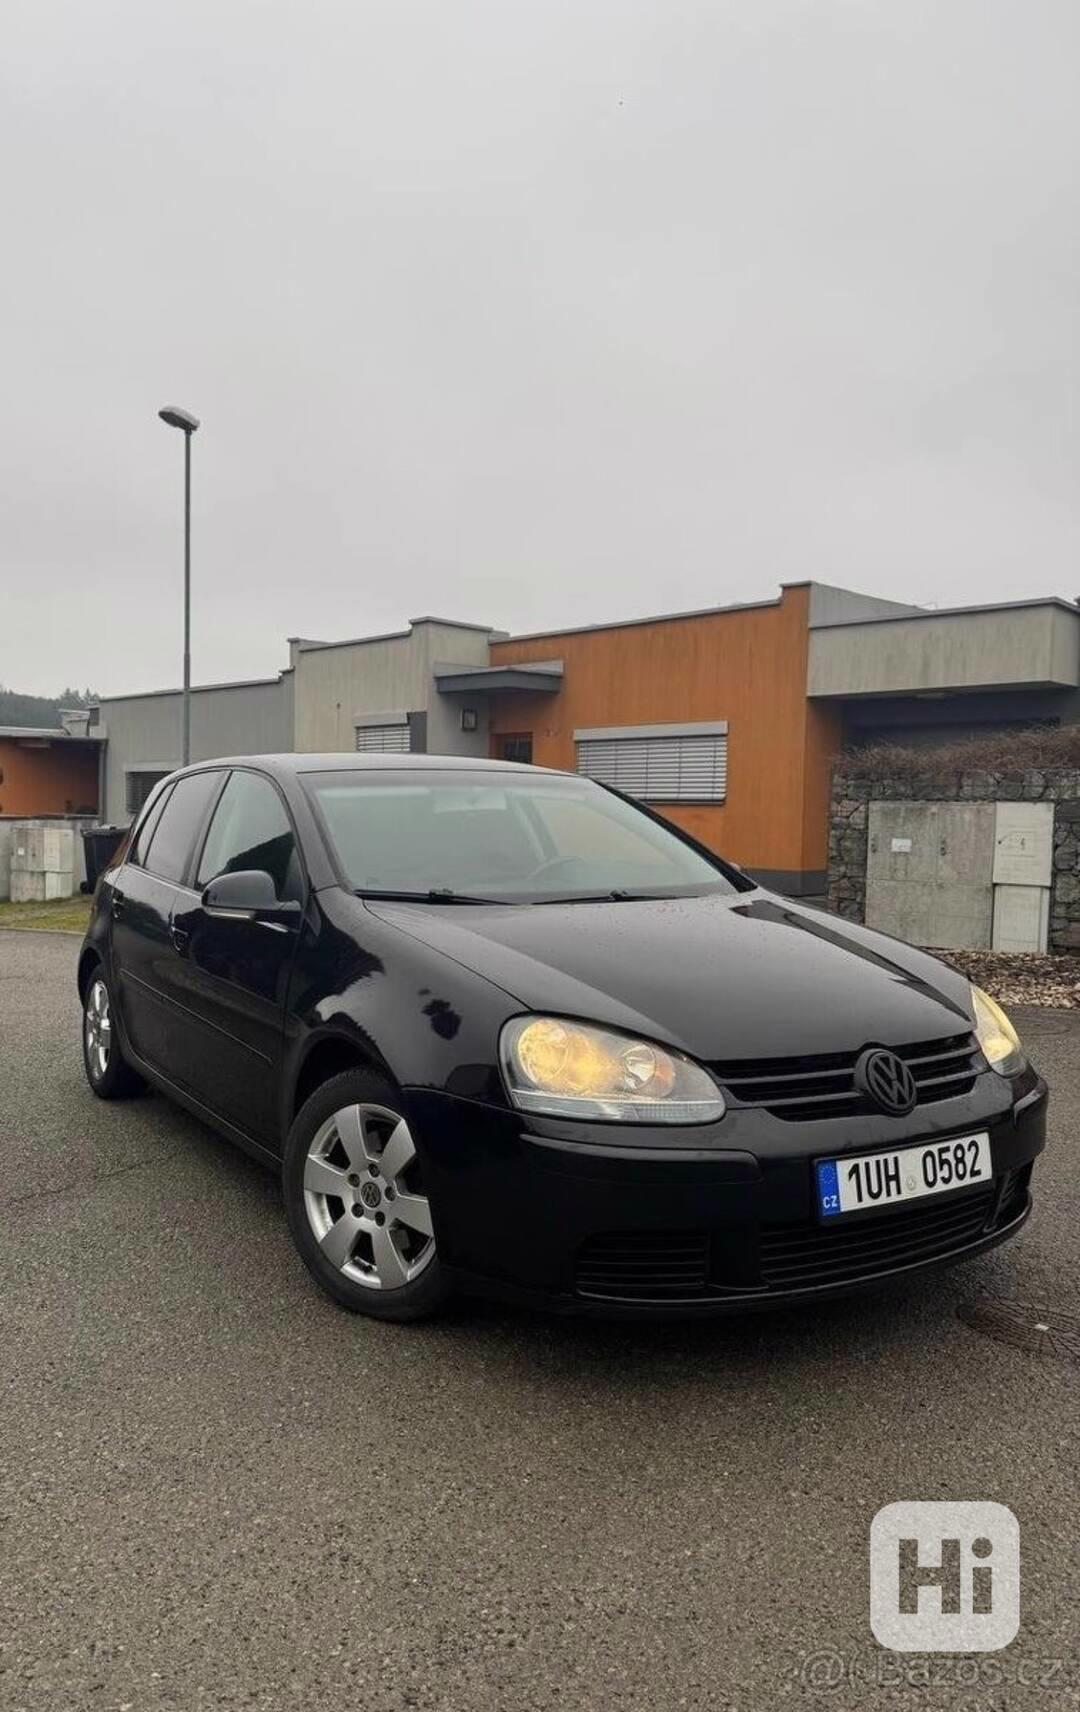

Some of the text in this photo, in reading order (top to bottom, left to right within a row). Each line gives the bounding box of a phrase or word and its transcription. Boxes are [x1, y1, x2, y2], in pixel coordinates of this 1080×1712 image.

[866, 1050, 915, 1109] VW
[847, 1139, 982, 1204] 1UH 0582
[822, 1194, 838, 1209] CZ
